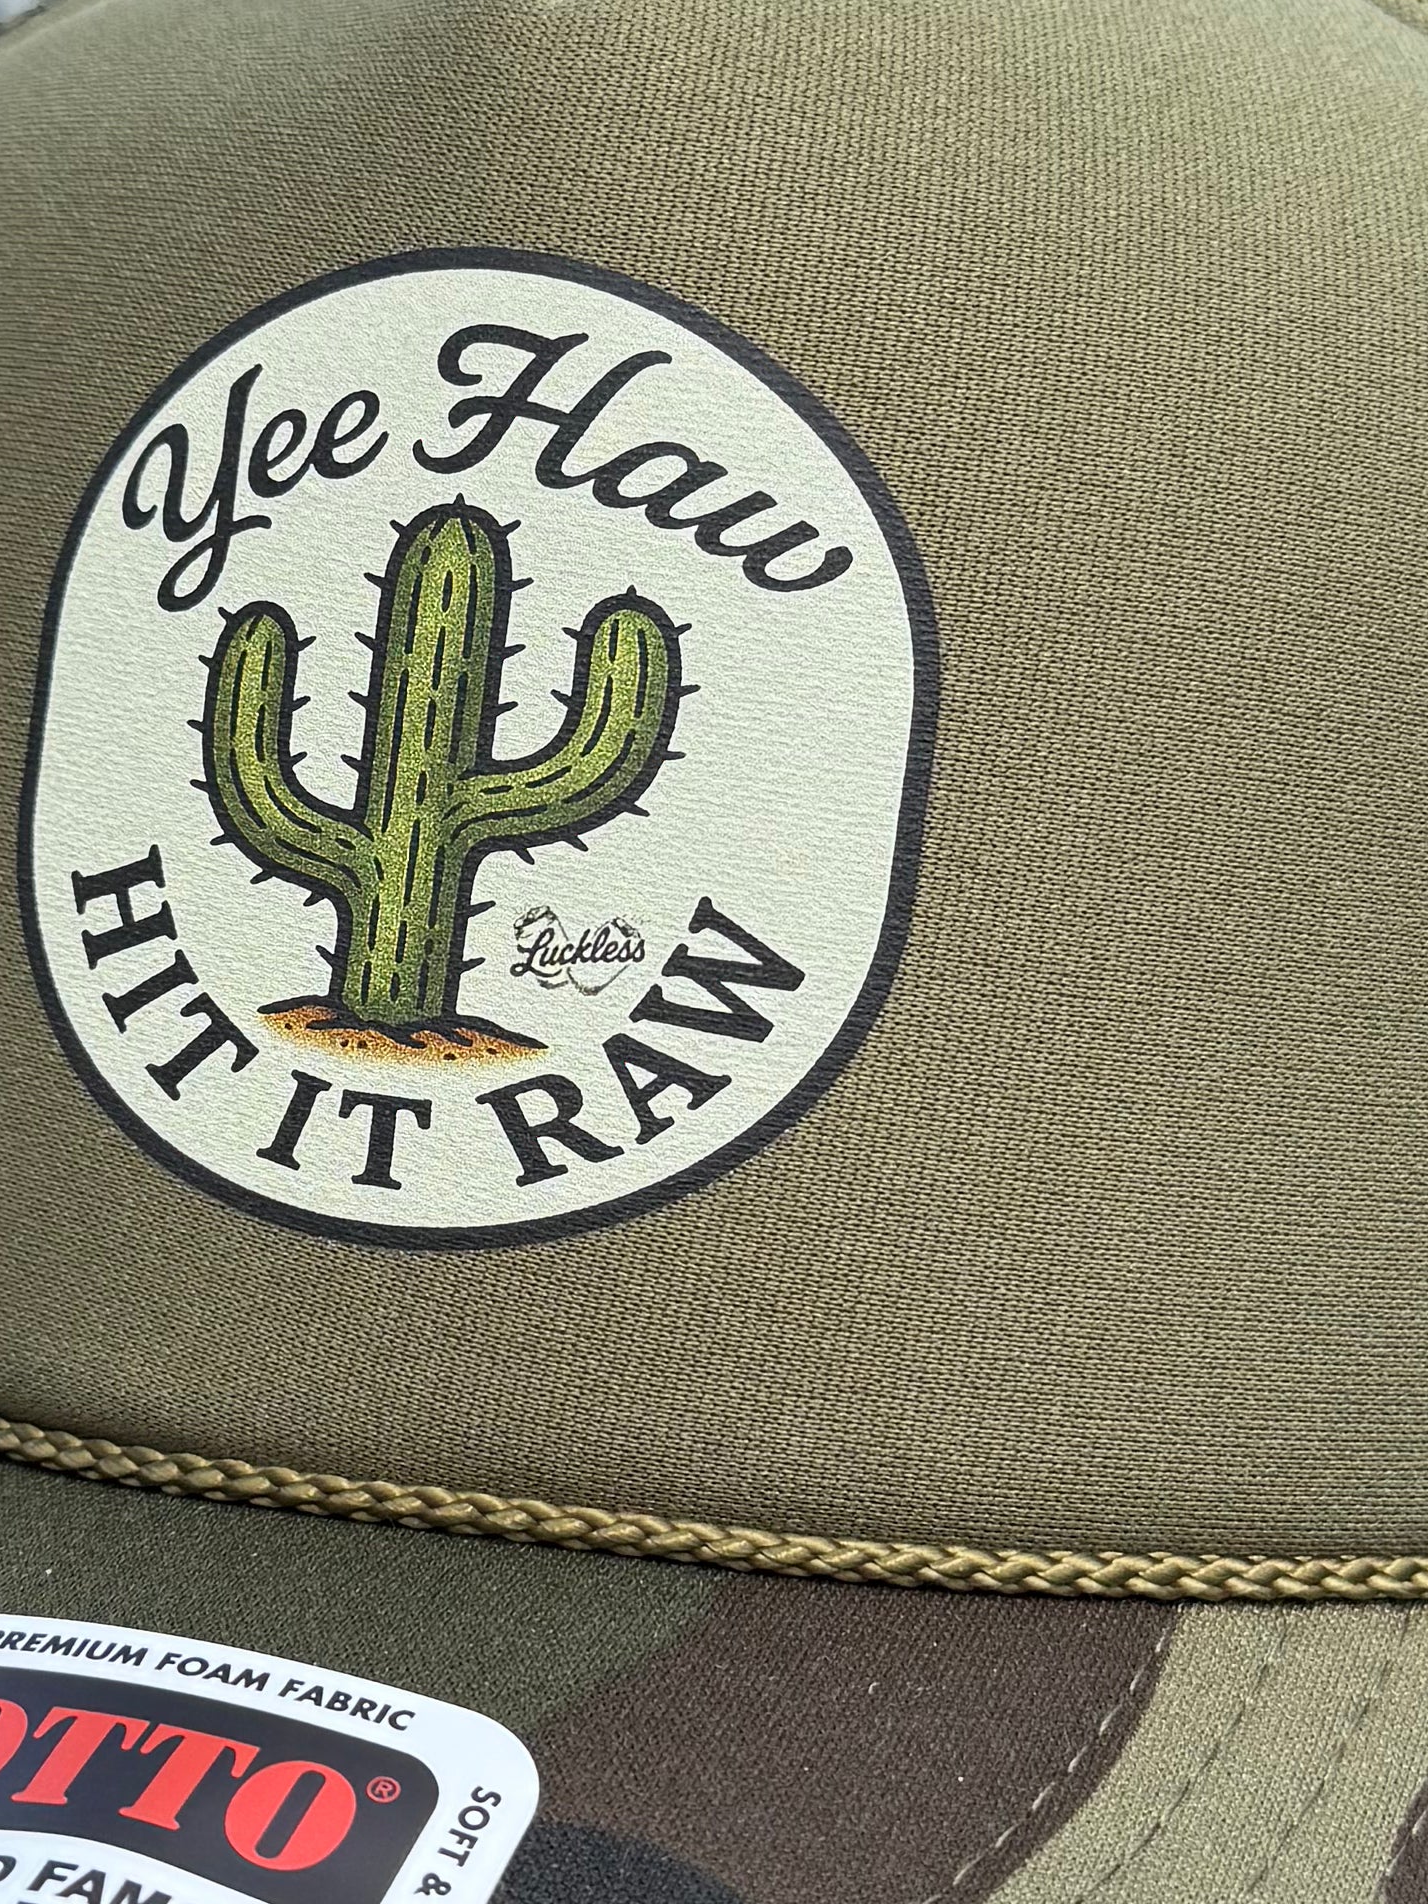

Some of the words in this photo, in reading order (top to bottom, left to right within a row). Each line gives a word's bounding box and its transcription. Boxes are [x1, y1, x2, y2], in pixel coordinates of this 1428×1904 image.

[123, 364, 390, 612] Yee
[413, 323, 854, 593] Haw
[510, 926, 646, 977] Luckless
[71, 844, 259, 1101] HIT
[256, 1069, 433, 1190] IT
[475, 896, 806, 1187] RAW
[156, 1650, 271, 1696] FOAM
[281, 1677, 417, 1733] FABRIC
[436, 1784, 503, 1869] SOFT
[422, 1871, 454, 1897] &
